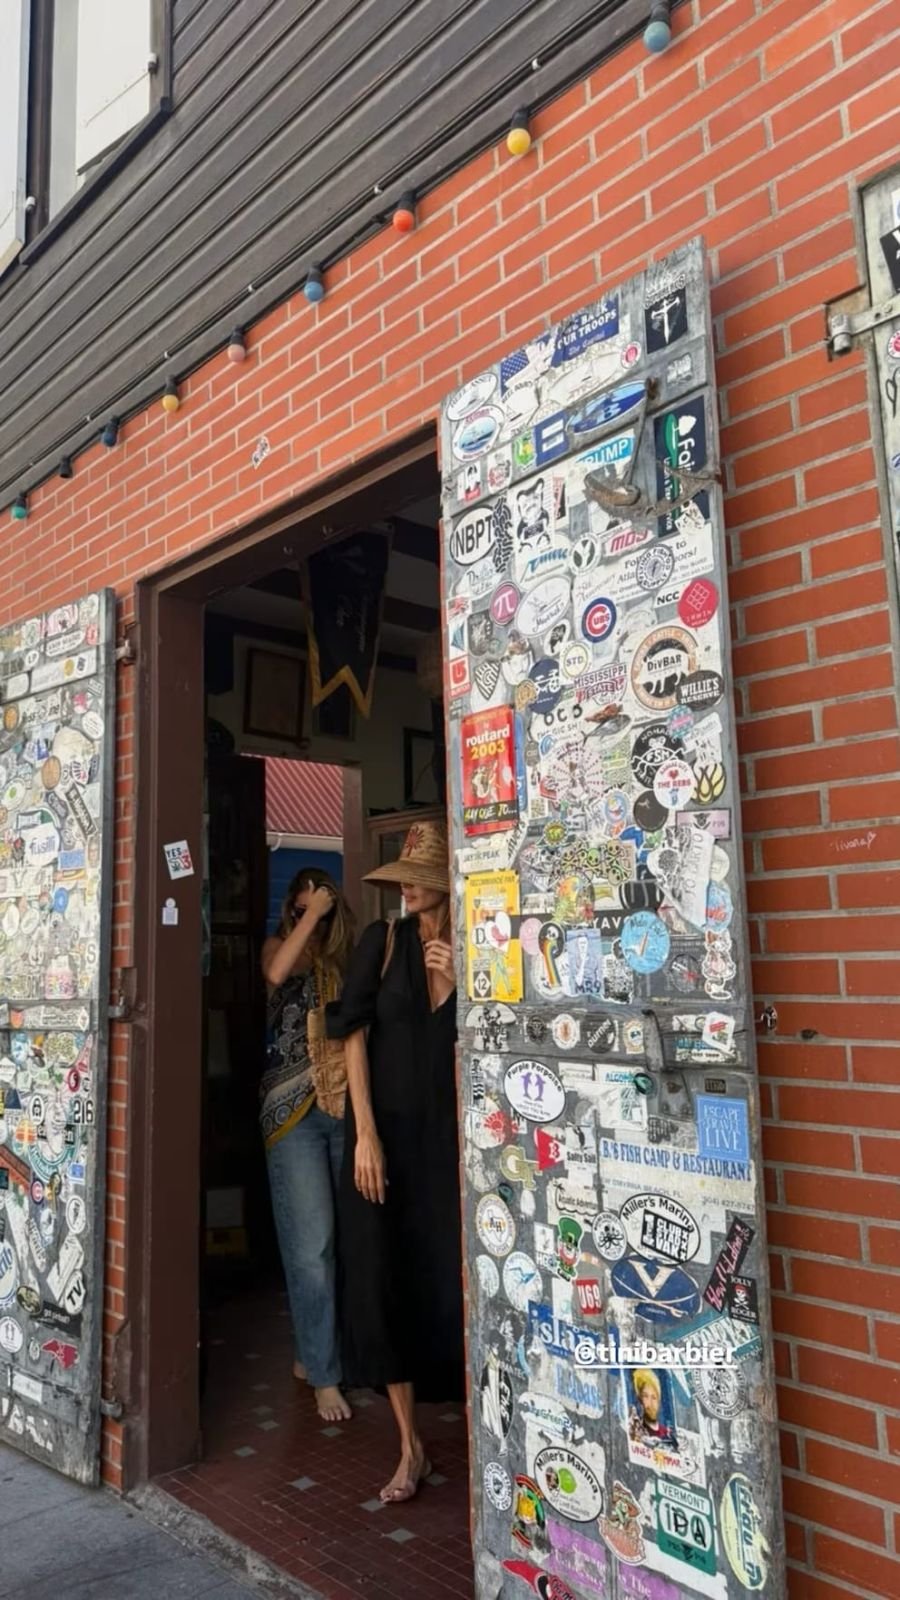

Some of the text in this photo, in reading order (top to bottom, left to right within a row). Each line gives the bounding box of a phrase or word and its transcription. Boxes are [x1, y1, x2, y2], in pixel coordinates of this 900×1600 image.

[580, 309, 617, 337] TROOPS
[583, 438, 629, 463] RUMP
[455, 515, 492, 557] NBPT
[657, 590, 680, 605] NCC
[574, 664, 626, 688] MISSISSIPPI
[681, 678, 719, 696] WILLIE'S
[466, 725, 510, 747] routard
[471, 741, 506, 760] 2003
[646, 752, 670, 763] FSM
[166, 847, 182, 858] YES
[508, 1062, 562, 1093] Purple Porpoise
[74, 1100, 94, 1124] 216
[706, 1129, 742, 1151] LIVE
[621, 1144, 641, 1164] FISH
[643, 1148, 670, 1169] CAMP
[673, 1154, 681, 1170] &
[622, 1197, 656, 1220] Miller's
[659, 1199, 695, 1232] Marina
[67, 1280, 82, 1306] TV
[731, 1276, 753, 1287] JOLLY
[731, 1307, 757, 1319] ROGER
[536, 1451, 565, 1471] Miller's
[567, 1453, 598, 1495] Marina
[662, 1483, 705, 1508] VERMONT
